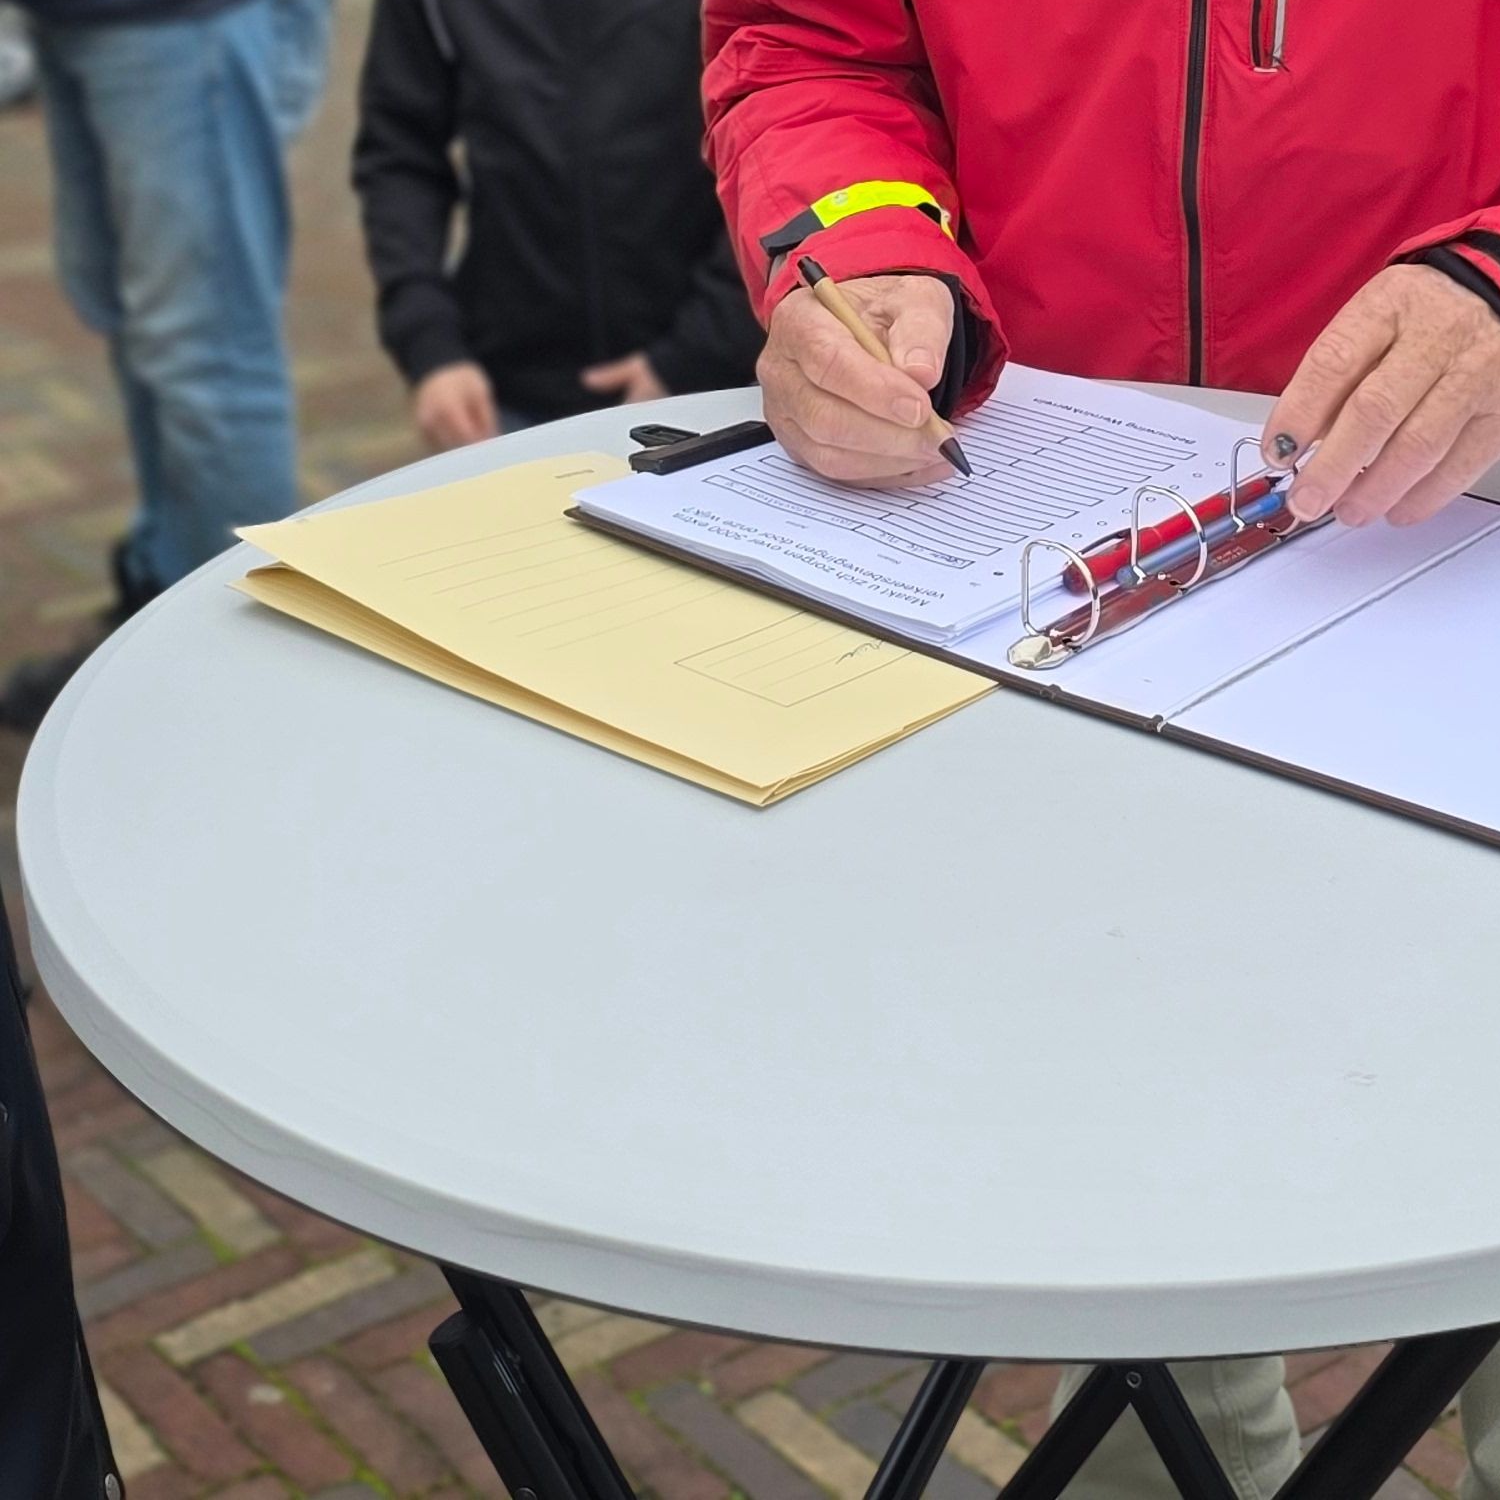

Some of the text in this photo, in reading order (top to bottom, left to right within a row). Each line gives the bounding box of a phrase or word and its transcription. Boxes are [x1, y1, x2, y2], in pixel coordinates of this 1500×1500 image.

[672, 512, 709, 526] extra
[722, 520, 759, 533] onze
[747, 539, 782, 550] over
[758, 532, 794, 544] door
[784, 549, 836, 572] zorgen
[795, 542, 945, 599] verkeersbewegingen
[836, 571, 868, 585] zich
[880, 587, 931, 606] Maakt
